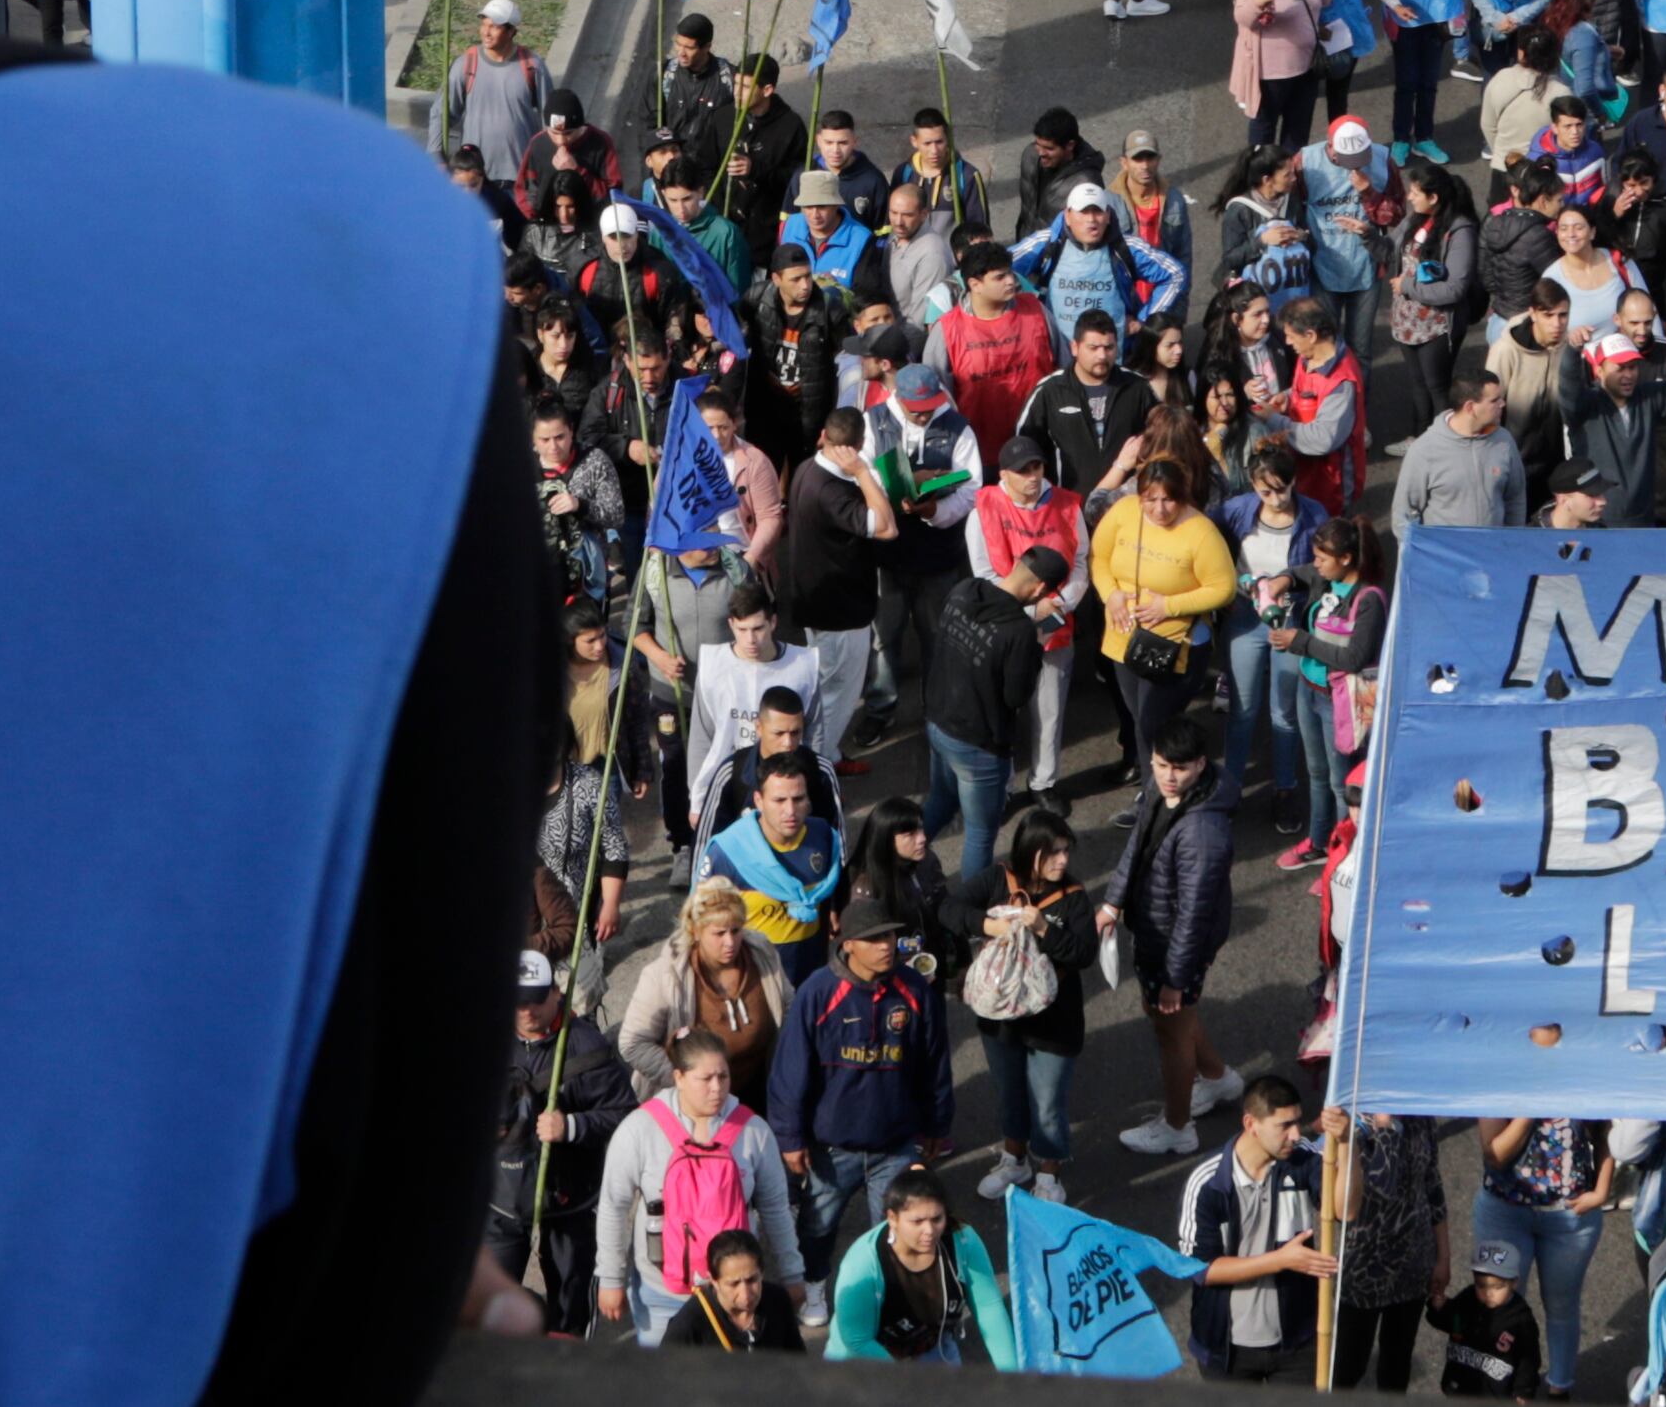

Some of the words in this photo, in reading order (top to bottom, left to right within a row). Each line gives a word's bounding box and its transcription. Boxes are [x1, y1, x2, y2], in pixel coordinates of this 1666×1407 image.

[1317, 194, 1364, 207] BARRIO
[1058, 278, 1113, 292] BARRIOS
[1064, 296, 1081, 308] DE
[1084, 298, 1103, 309] PIE
[1095, 1268, 1135, 1315] PIE
